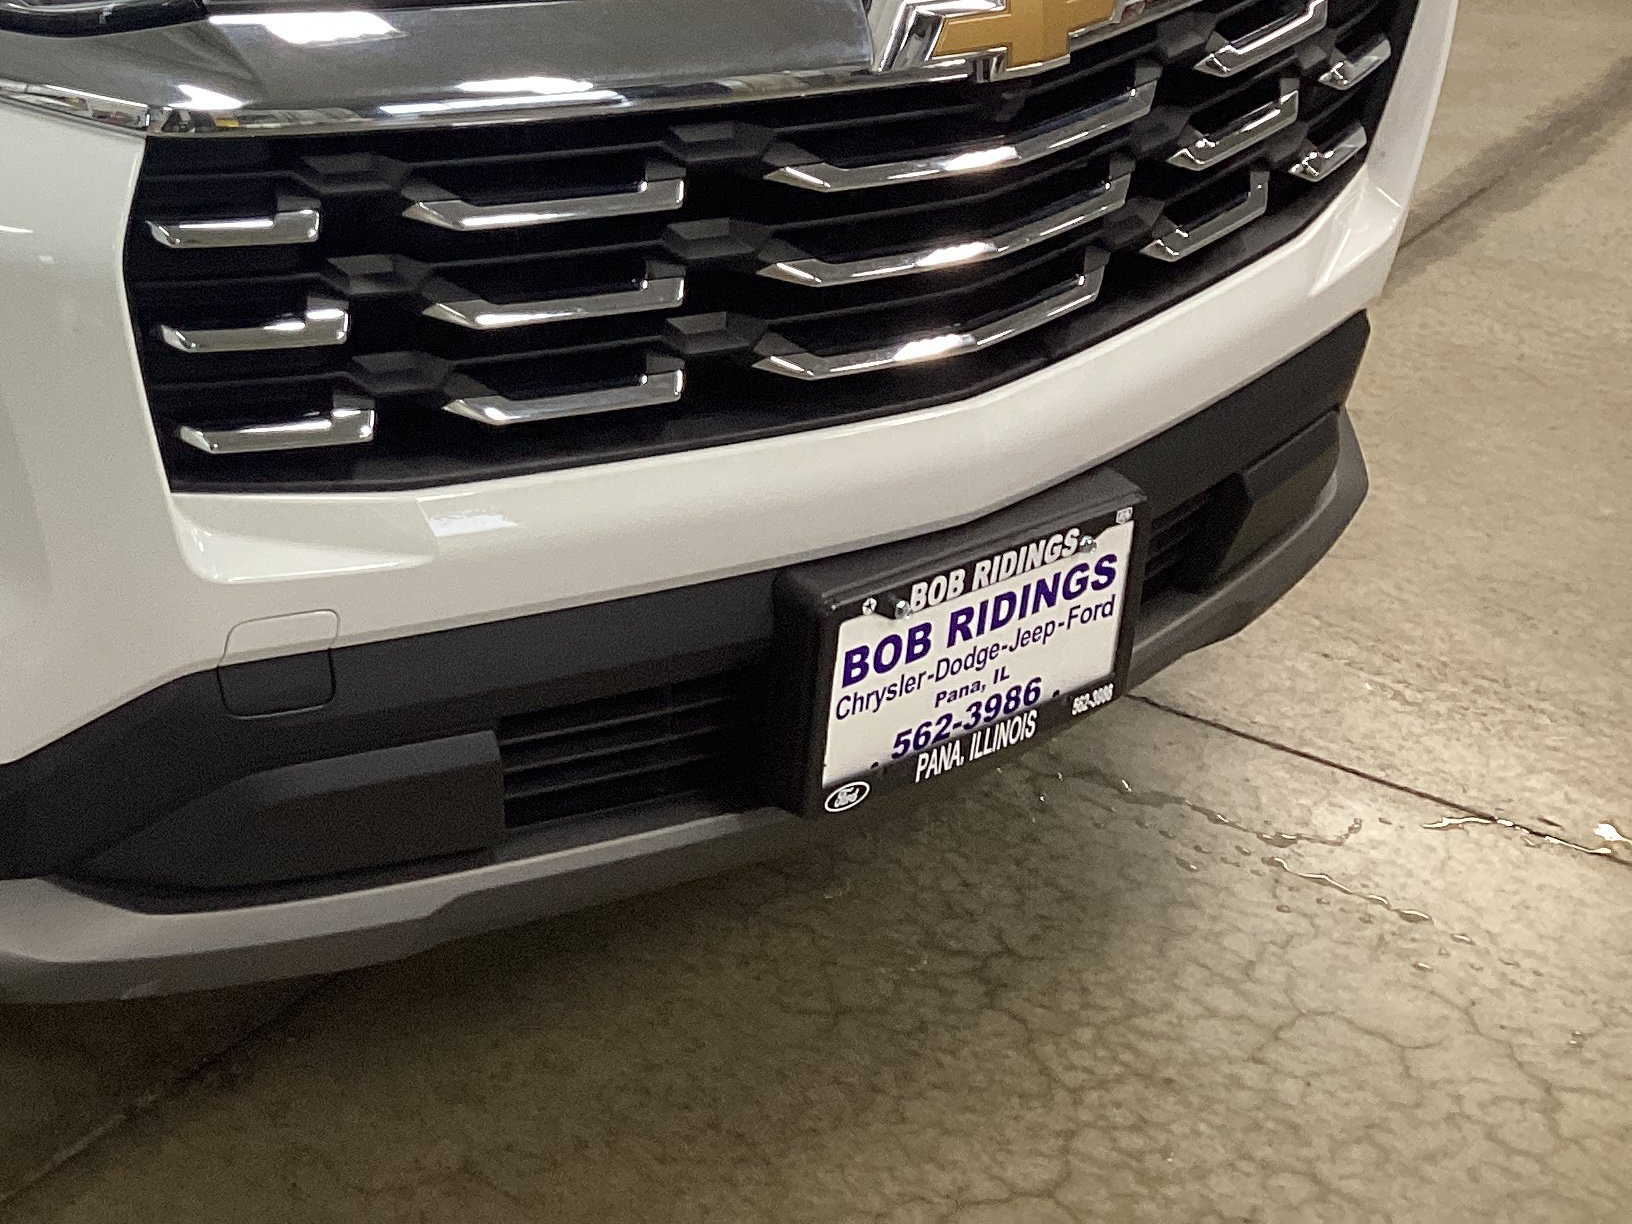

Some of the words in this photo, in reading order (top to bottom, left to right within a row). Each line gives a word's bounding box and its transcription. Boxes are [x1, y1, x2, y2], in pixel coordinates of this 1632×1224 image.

[910, 568, 966, 612] BOB
[972, 528, 1080, 590] RIDINGS
[835, 594, 1116, 721] Chrysler-Dodge-Jeep-Ford
[841, 622, 932, 688] BOB
[946, 553, 1118, 648] RIDINGS
[891, 677, 1042, 760] 562-3986
[934, 680, 987, 708] Pana,
[992, 666, 1010, 687] IL
[915, 743, 965, 783] PANA,
[968, 709, 1038, 762] ILLINOIS
